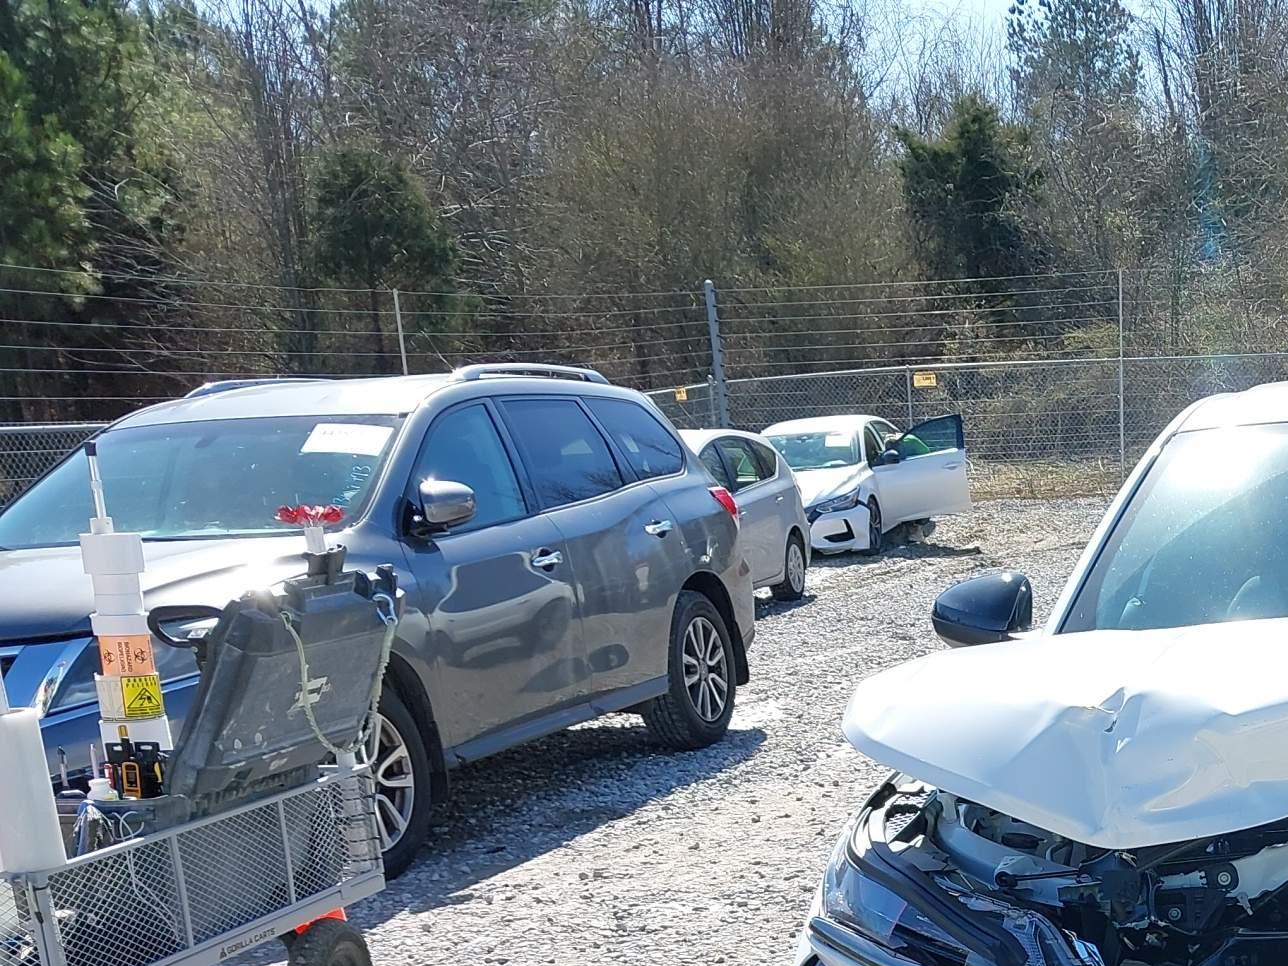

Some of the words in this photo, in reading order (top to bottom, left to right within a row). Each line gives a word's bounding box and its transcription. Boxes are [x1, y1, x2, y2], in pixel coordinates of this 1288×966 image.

[124, 641, 133, 673] BIOHAZARD
[226, 938, 254, 954] GORILLA
[254, 927, 276, 942] CARTS
